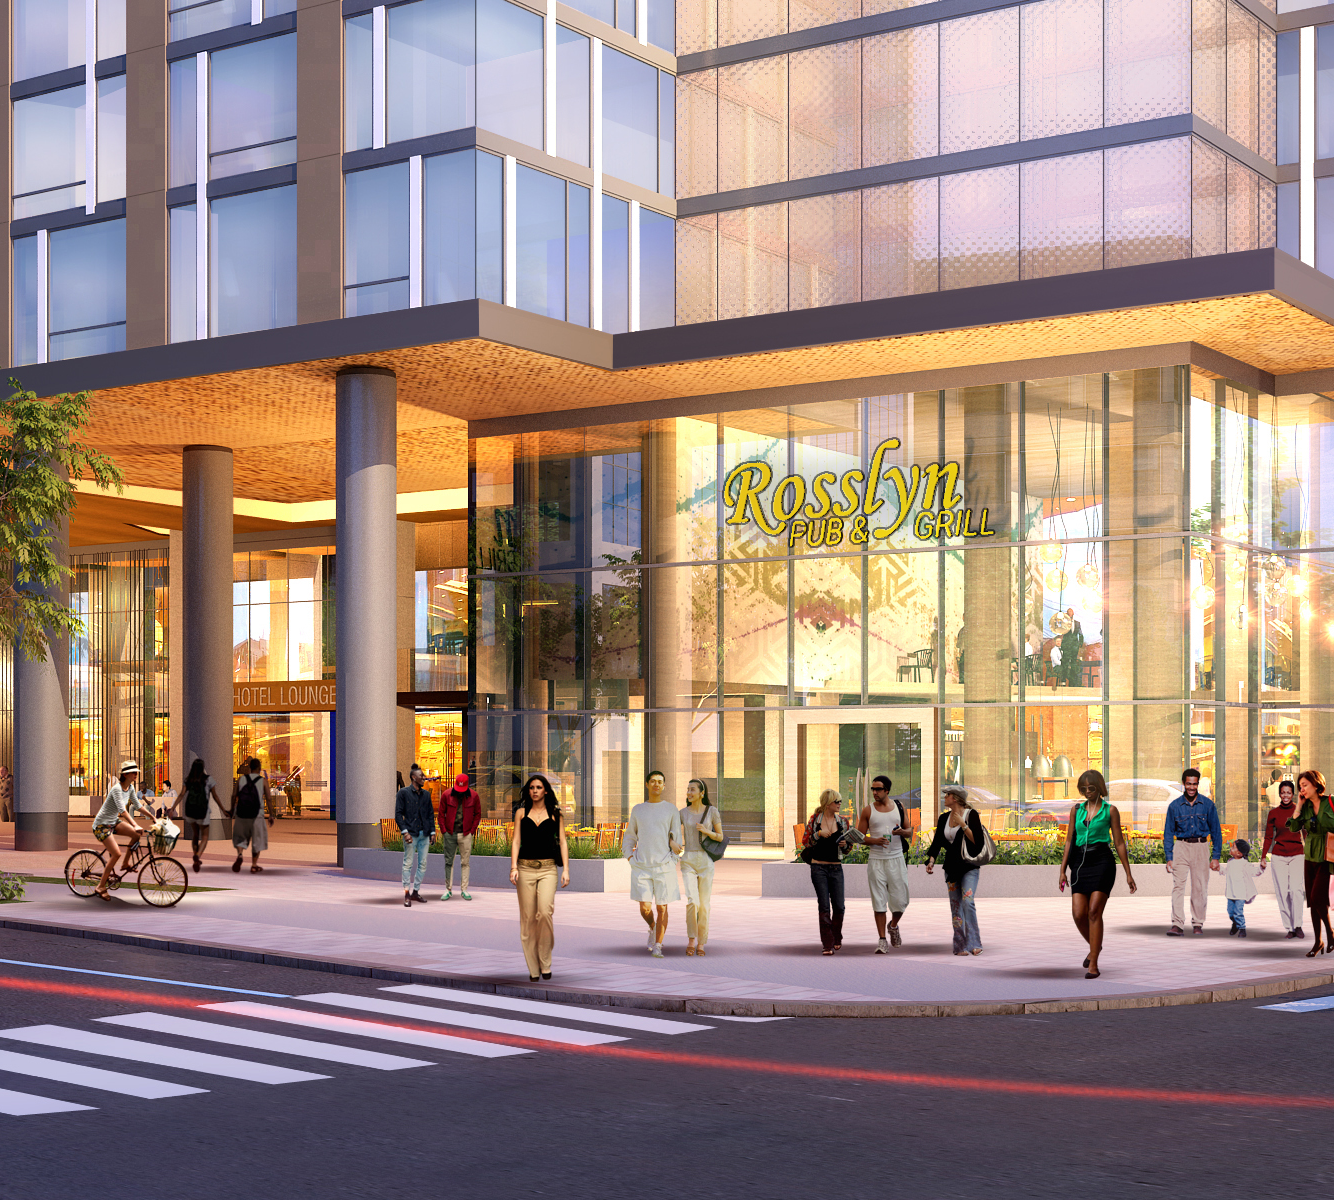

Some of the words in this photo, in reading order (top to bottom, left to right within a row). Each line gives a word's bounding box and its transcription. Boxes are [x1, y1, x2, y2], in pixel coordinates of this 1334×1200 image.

[723, 437, 963, 539] Rosslyn
[789, 515, 844, 548] PUB
[849, 515, 870, 544] &
[913, 507, 995, 540] GRILL
[233, 687, 276, 706] HOTEL
[280, 685, 336, 705] LOUNGE
